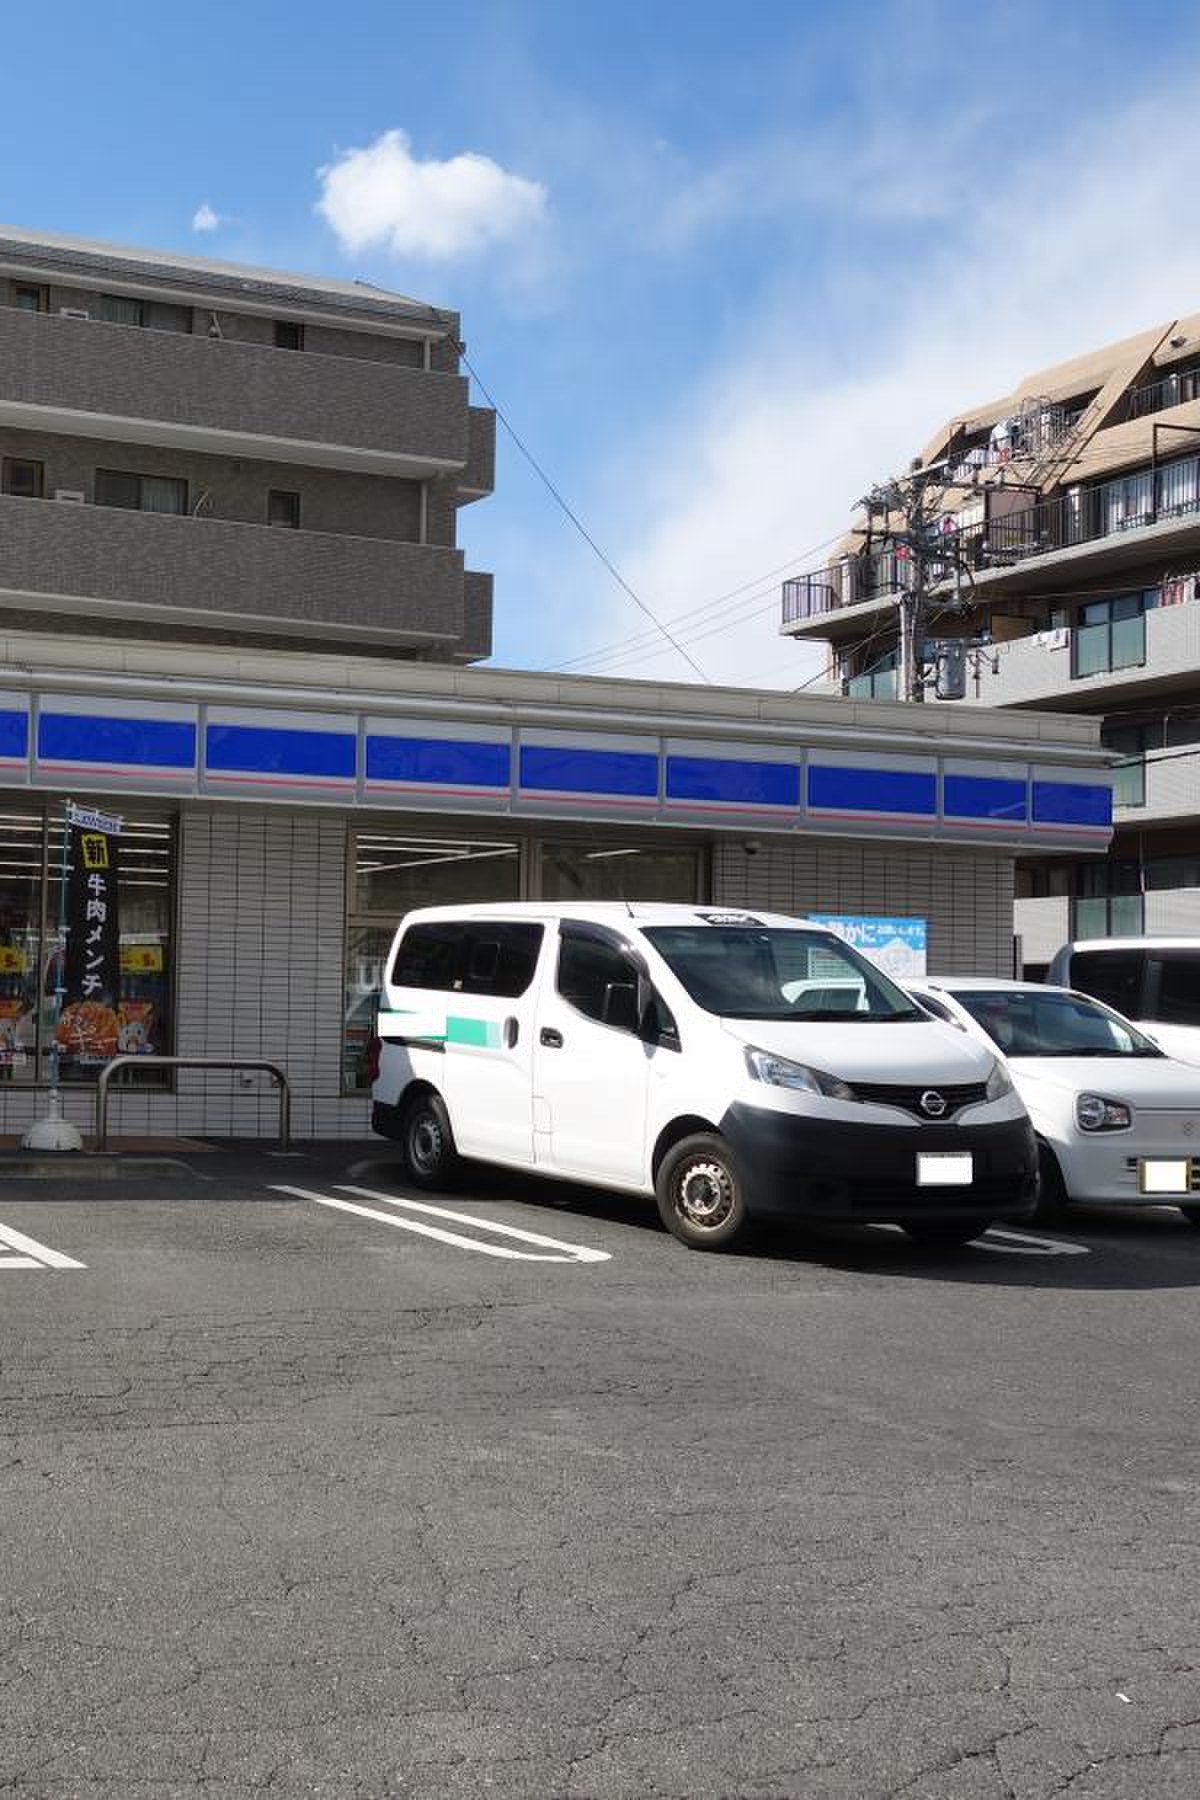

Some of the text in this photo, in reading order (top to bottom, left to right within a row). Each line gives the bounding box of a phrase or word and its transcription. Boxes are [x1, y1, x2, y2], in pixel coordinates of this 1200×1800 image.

[81, 873, 107, 995] 牛肉メンチ
